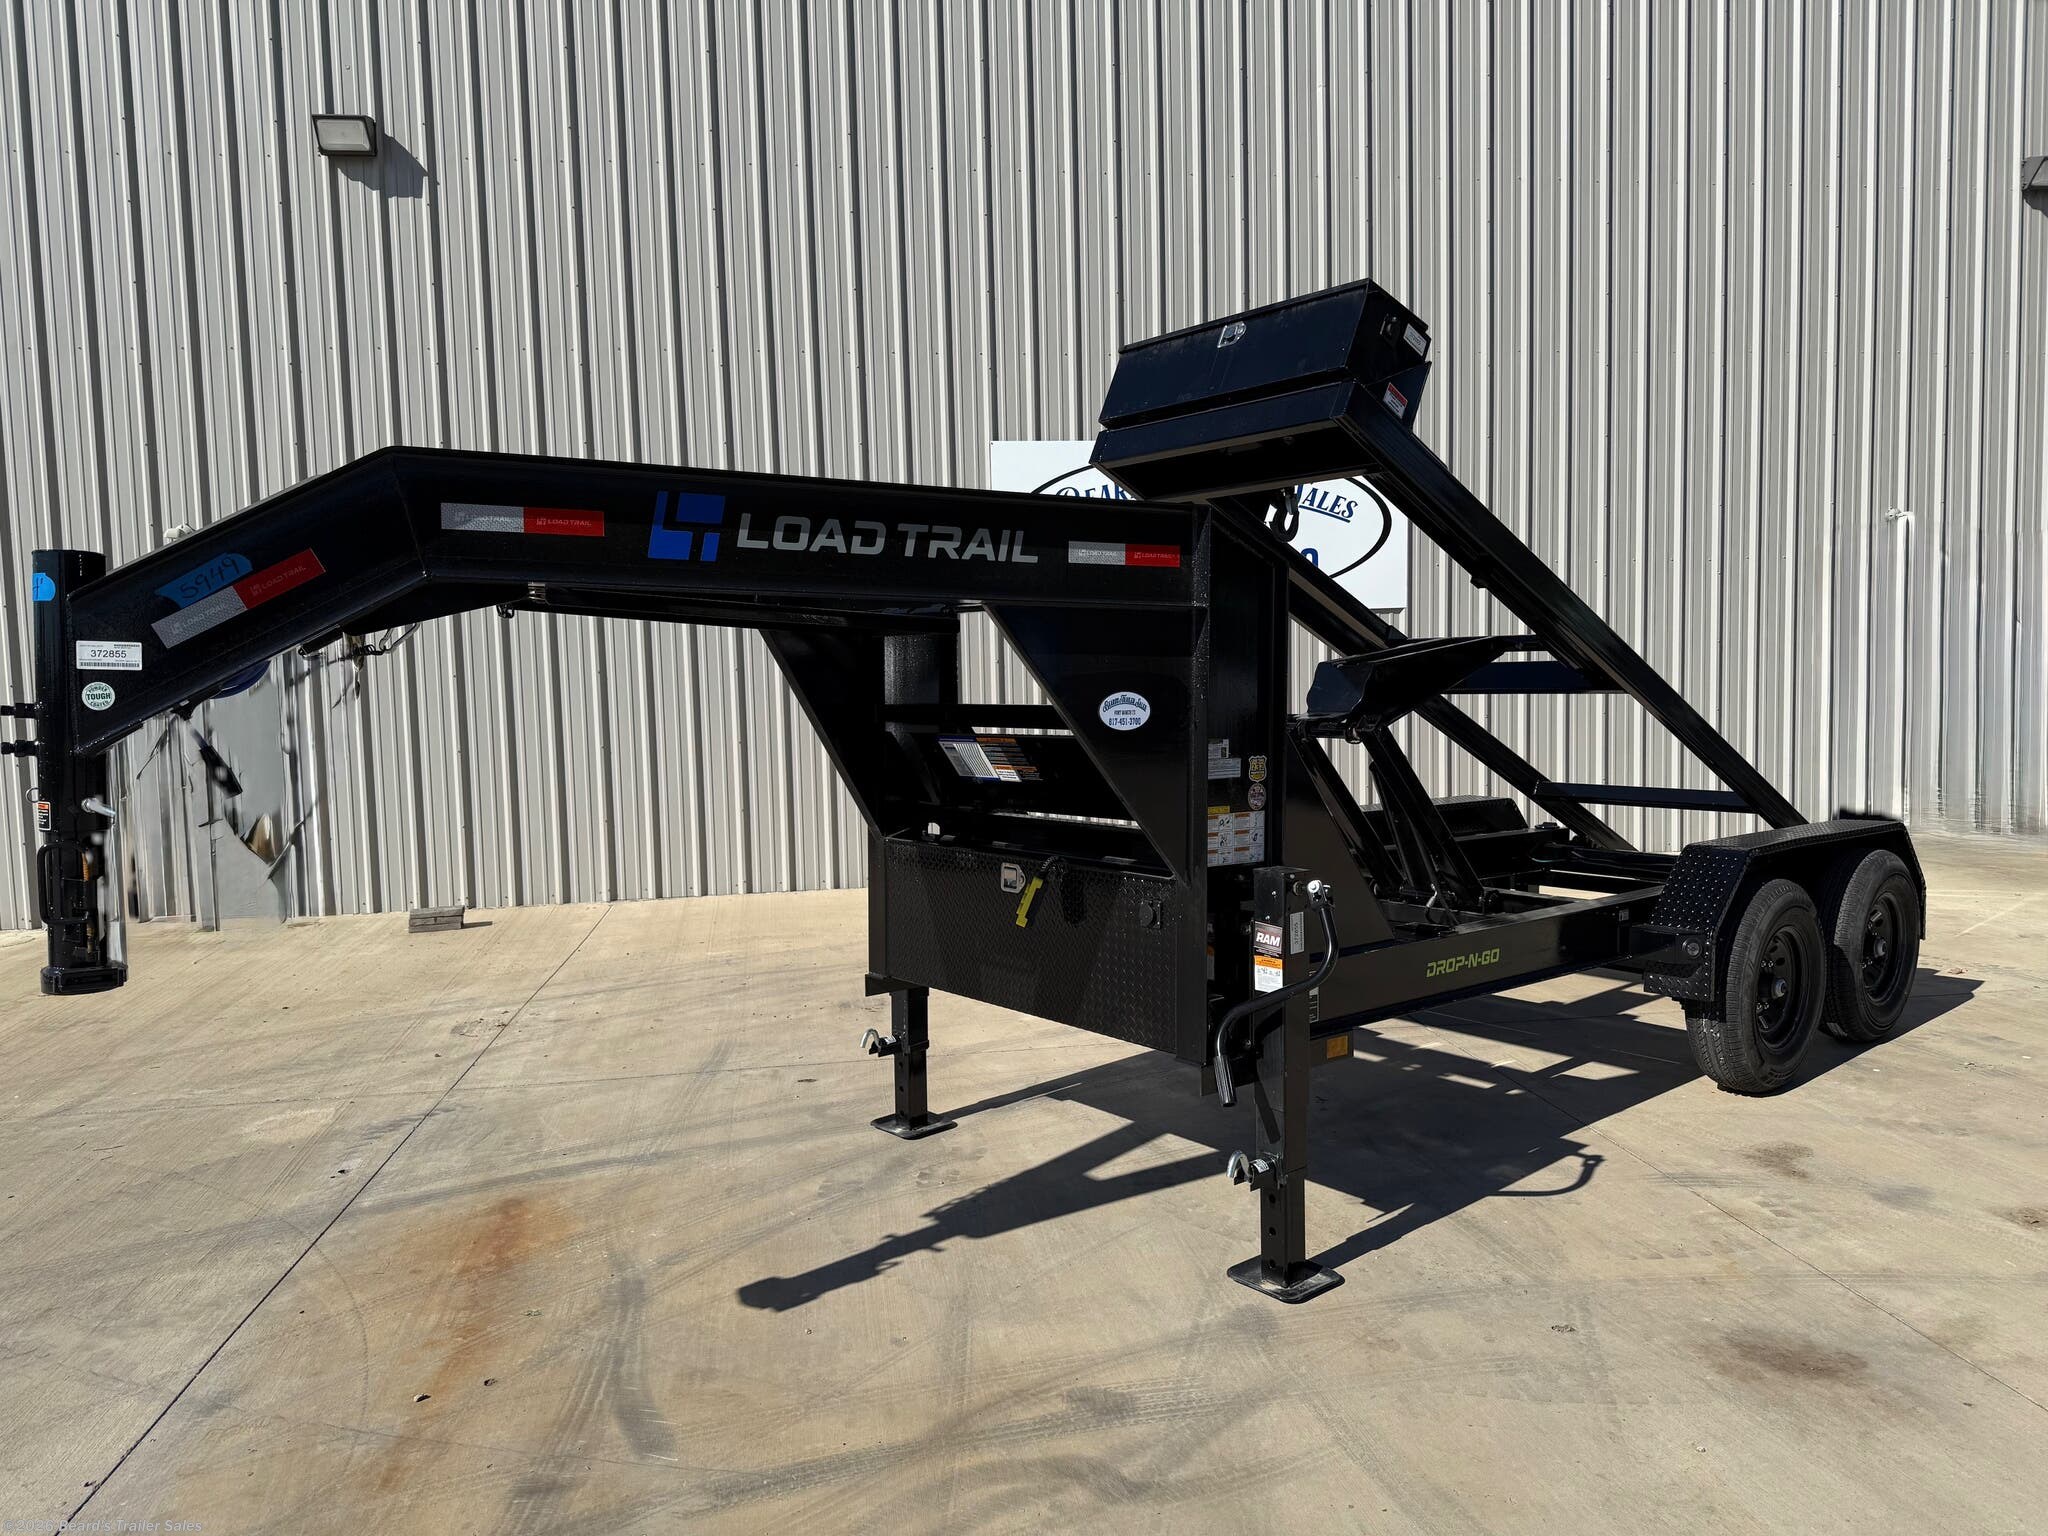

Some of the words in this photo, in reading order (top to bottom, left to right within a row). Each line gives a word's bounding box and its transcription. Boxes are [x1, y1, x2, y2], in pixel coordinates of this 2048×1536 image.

[1297, 485, 1358, 519] ALES
[547, 518, 569, 526] LOAD
[569, 519, 592, 527] TRAIL
[737, 512, 887, 556] LOAD
[897, 523, 1039, 564] TRAIL
[260, 574, 283, 591] LOAD
[282, 565, 308, 583] TRAIL
[90, 649, 127, 659] 372855
[86, 692, 111, 701] TOUGH
[1108, 717, 1142, 726] 817-451-3700
[1255, 931, 1281, 947] RAM
[1425, 947, 1501, 978] DROP-N-GO
